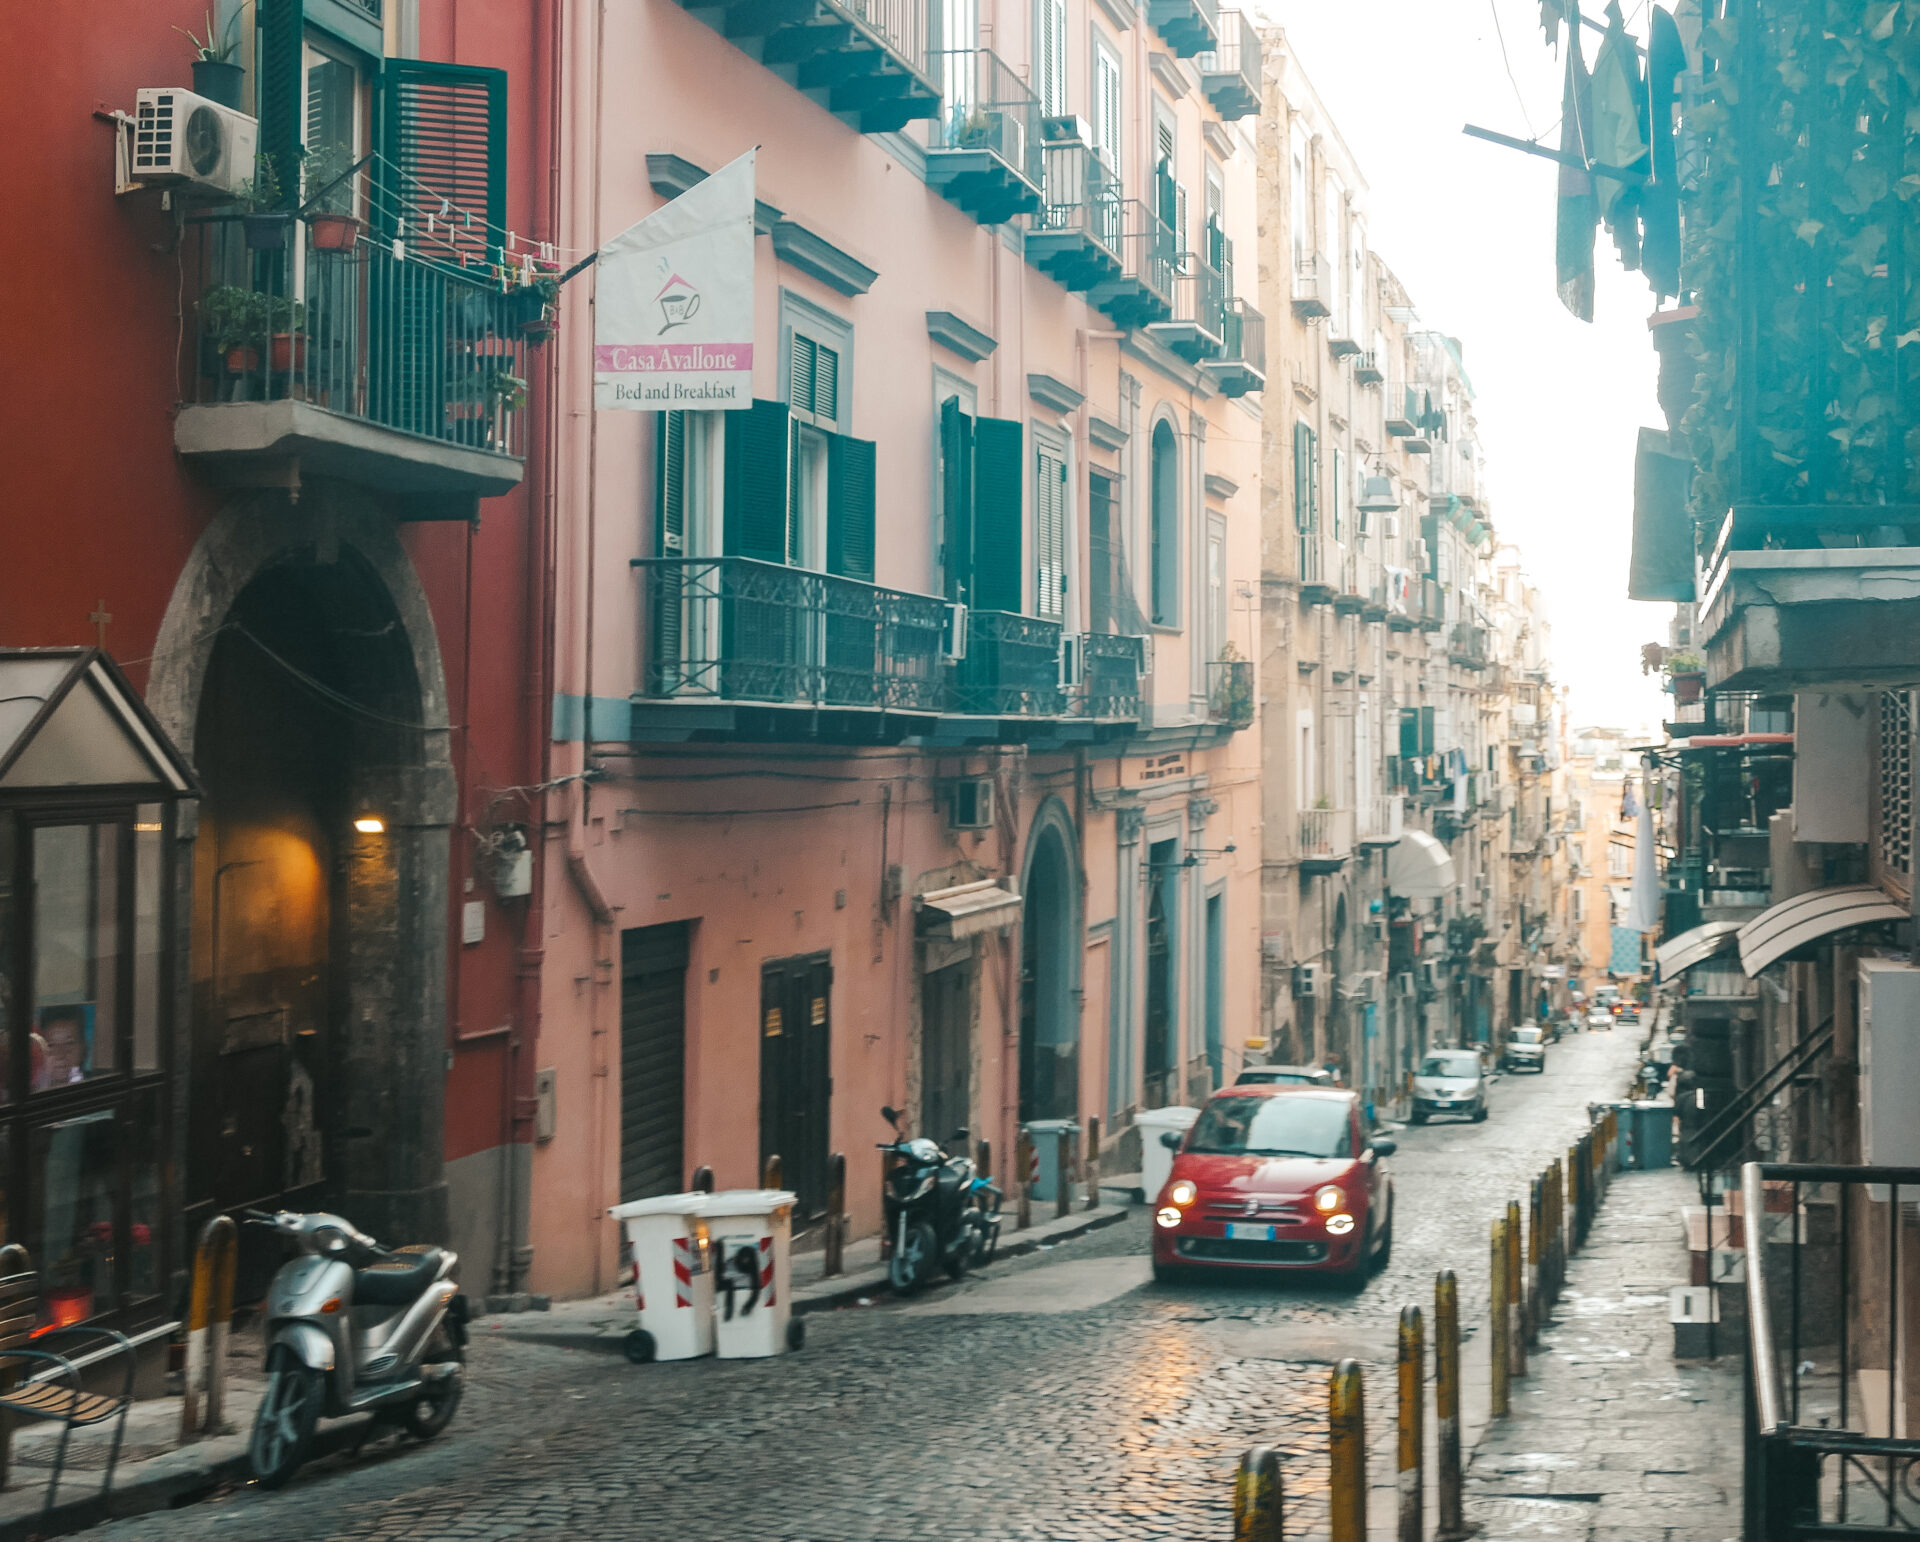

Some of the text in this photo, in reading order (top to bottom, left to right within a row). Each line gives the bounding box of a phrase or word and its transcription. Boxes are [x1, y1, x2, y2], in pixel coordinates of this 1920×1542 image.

[612, 345, 737, 370] Casa Avallone
[616, 381, 736, 400] Bed and Breakfast
